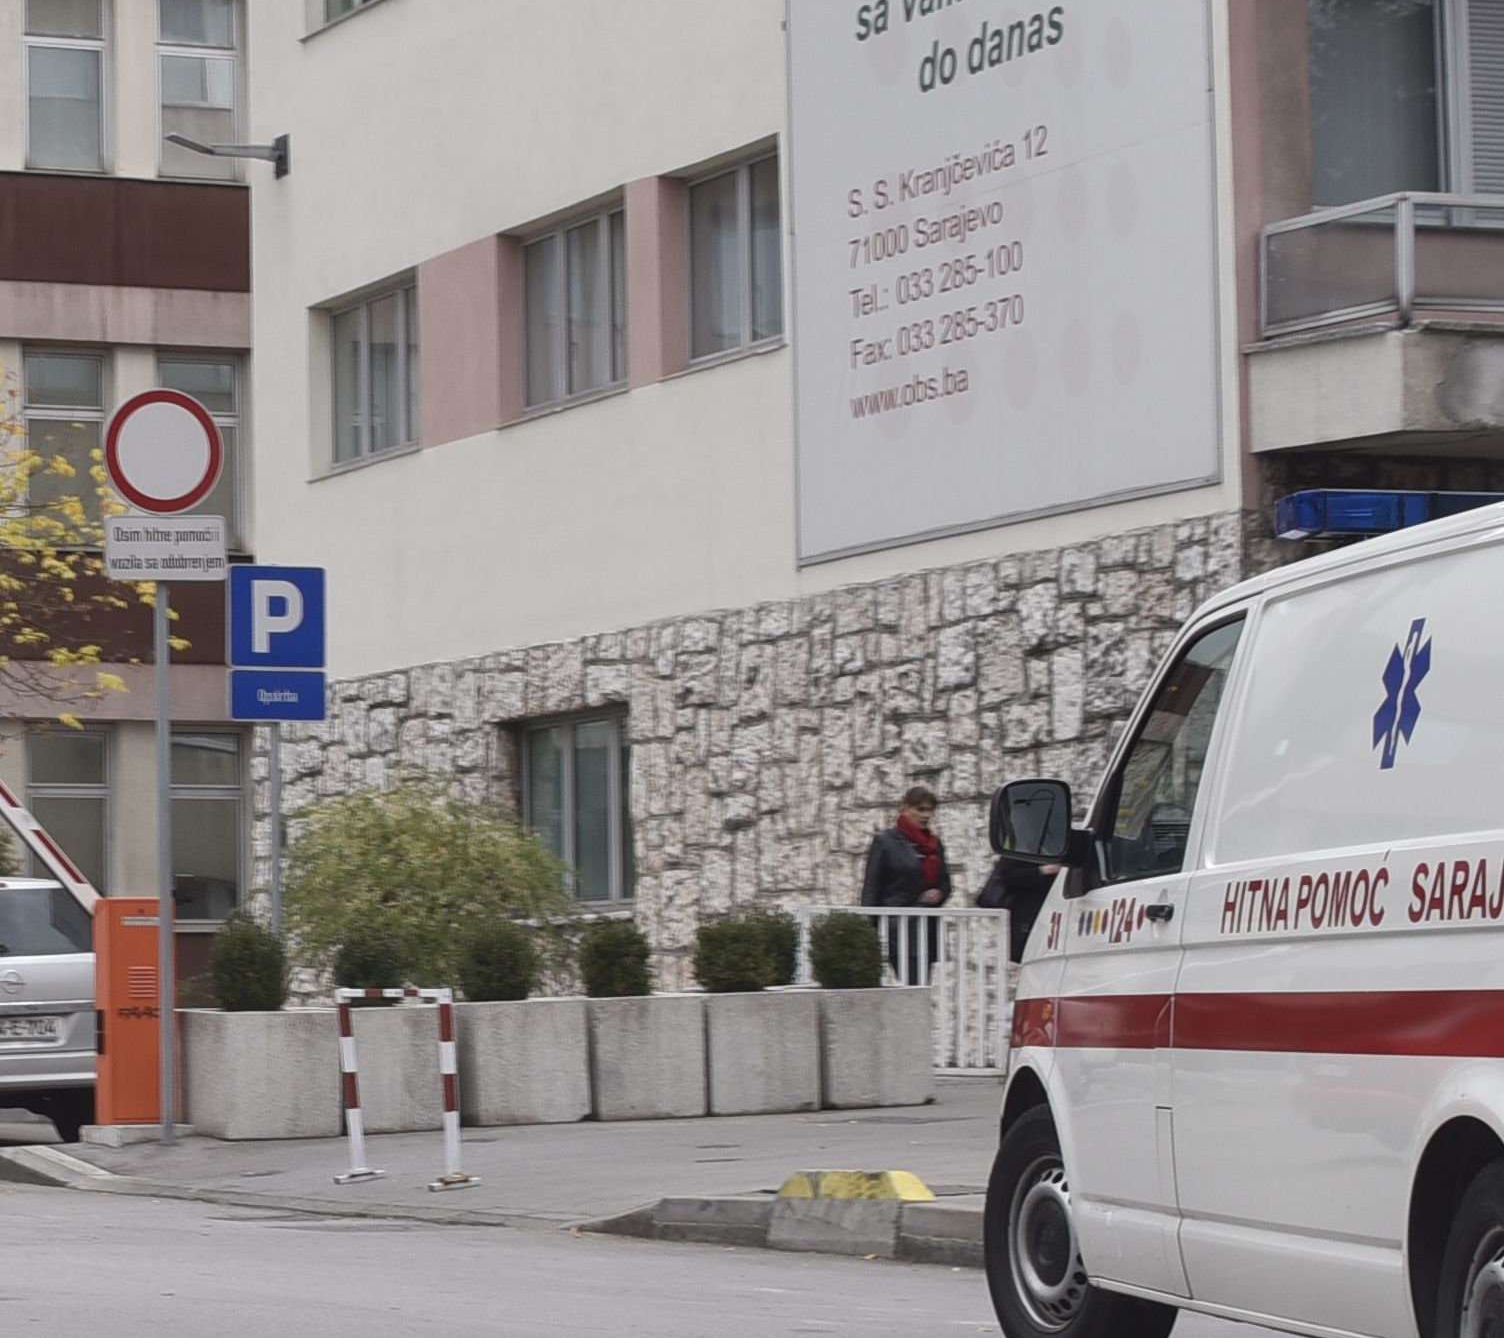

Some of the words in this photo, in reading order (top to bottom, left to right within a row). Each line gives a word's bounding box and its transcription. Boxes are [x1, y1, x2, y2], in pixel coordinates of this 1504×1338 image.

[919, 40, 957, 93] do
[967, 6, 1064, 75] danas
[848, 188, 869, 218] S.
[873, 179, 894, 209] S.
[898, 140, 1016, 202] Kranjčevića
[1022, 125, 1049, 160] 12
[848, 224, 909, 269] 71000
[913, 201, 1003, 248] Sarajevo
[848, 284, 889, 318] Tel.:
[896, 268, 934, 305] 033
[939, 240, 1024, 293] 285-100
[850, 338, 892, 369] Fax:
[897, 319, 935, 356] 033
[939, 293, 1025, 345] 285-370
[850, 366, 970, 419] www.obs.ba
[113, 526, 142, 543] Osim
[144, 557, 158, 570] sa
[251, 579, 304, 653] P
[1108, 897, 1137, 943] 124
[1220, 877, 1290, 934] HITNA
[1293, 849, 1390, 929] POMOĆ
[1047, 911, 1062, 950] 31
